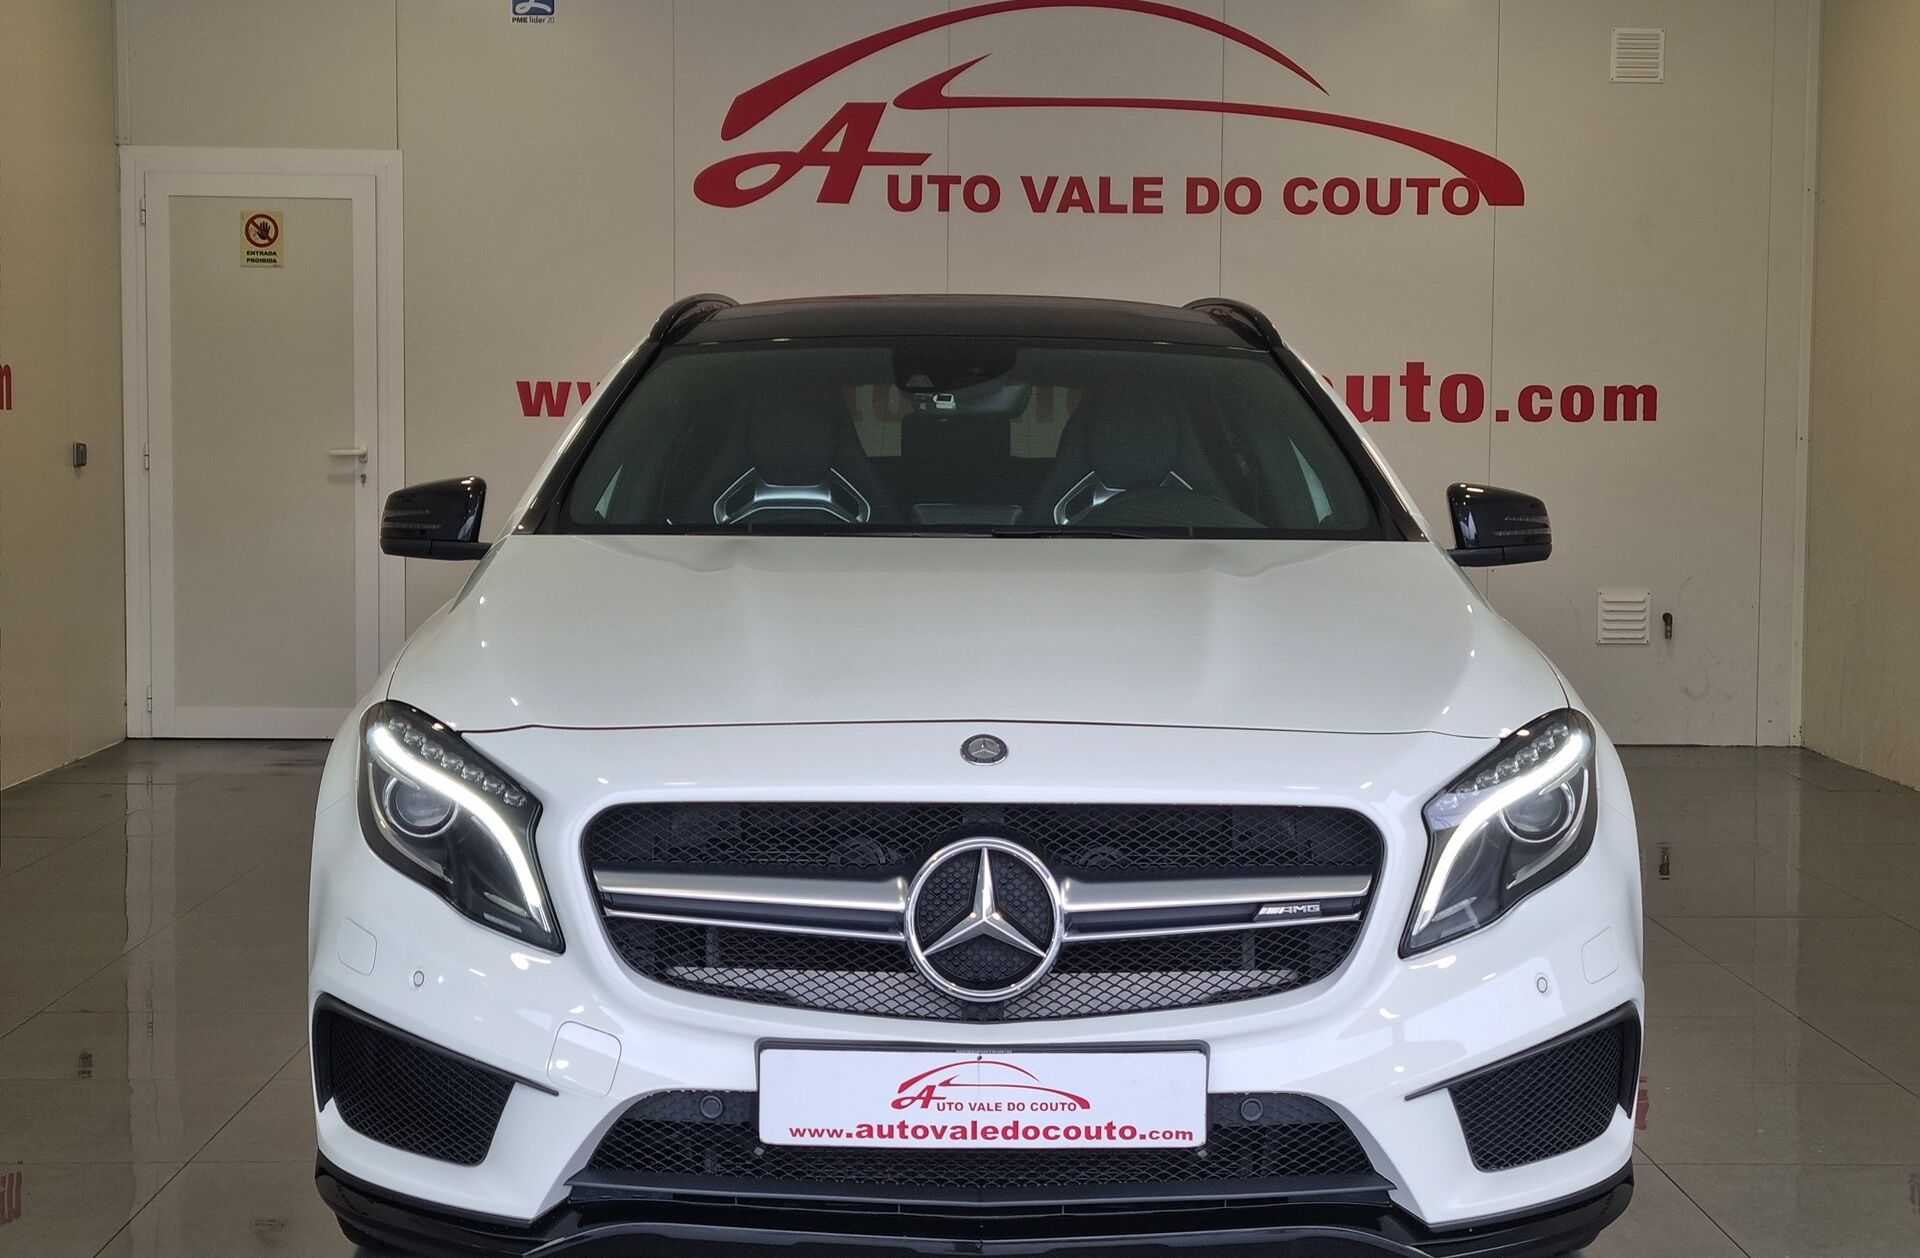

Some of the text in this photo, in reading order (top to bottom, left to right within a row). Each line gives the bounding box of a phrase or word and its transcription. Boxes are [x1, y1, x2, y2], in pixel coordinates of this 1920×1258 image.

[1021, 175, 1163, 214] VALE
[1185, 176, 1262, 215] DO
[1283, 176, 1480, 216] COUTO
[1281, 905, 1320, 914] AMG
[968, 1102, 1002, 1112] VALE
[1007, 1102, 1026, 1112] DO
[1030, 1102, 1077, 1112] COUTO
[789, 1119, 1194, 1142] www.autovaledocouto.com
